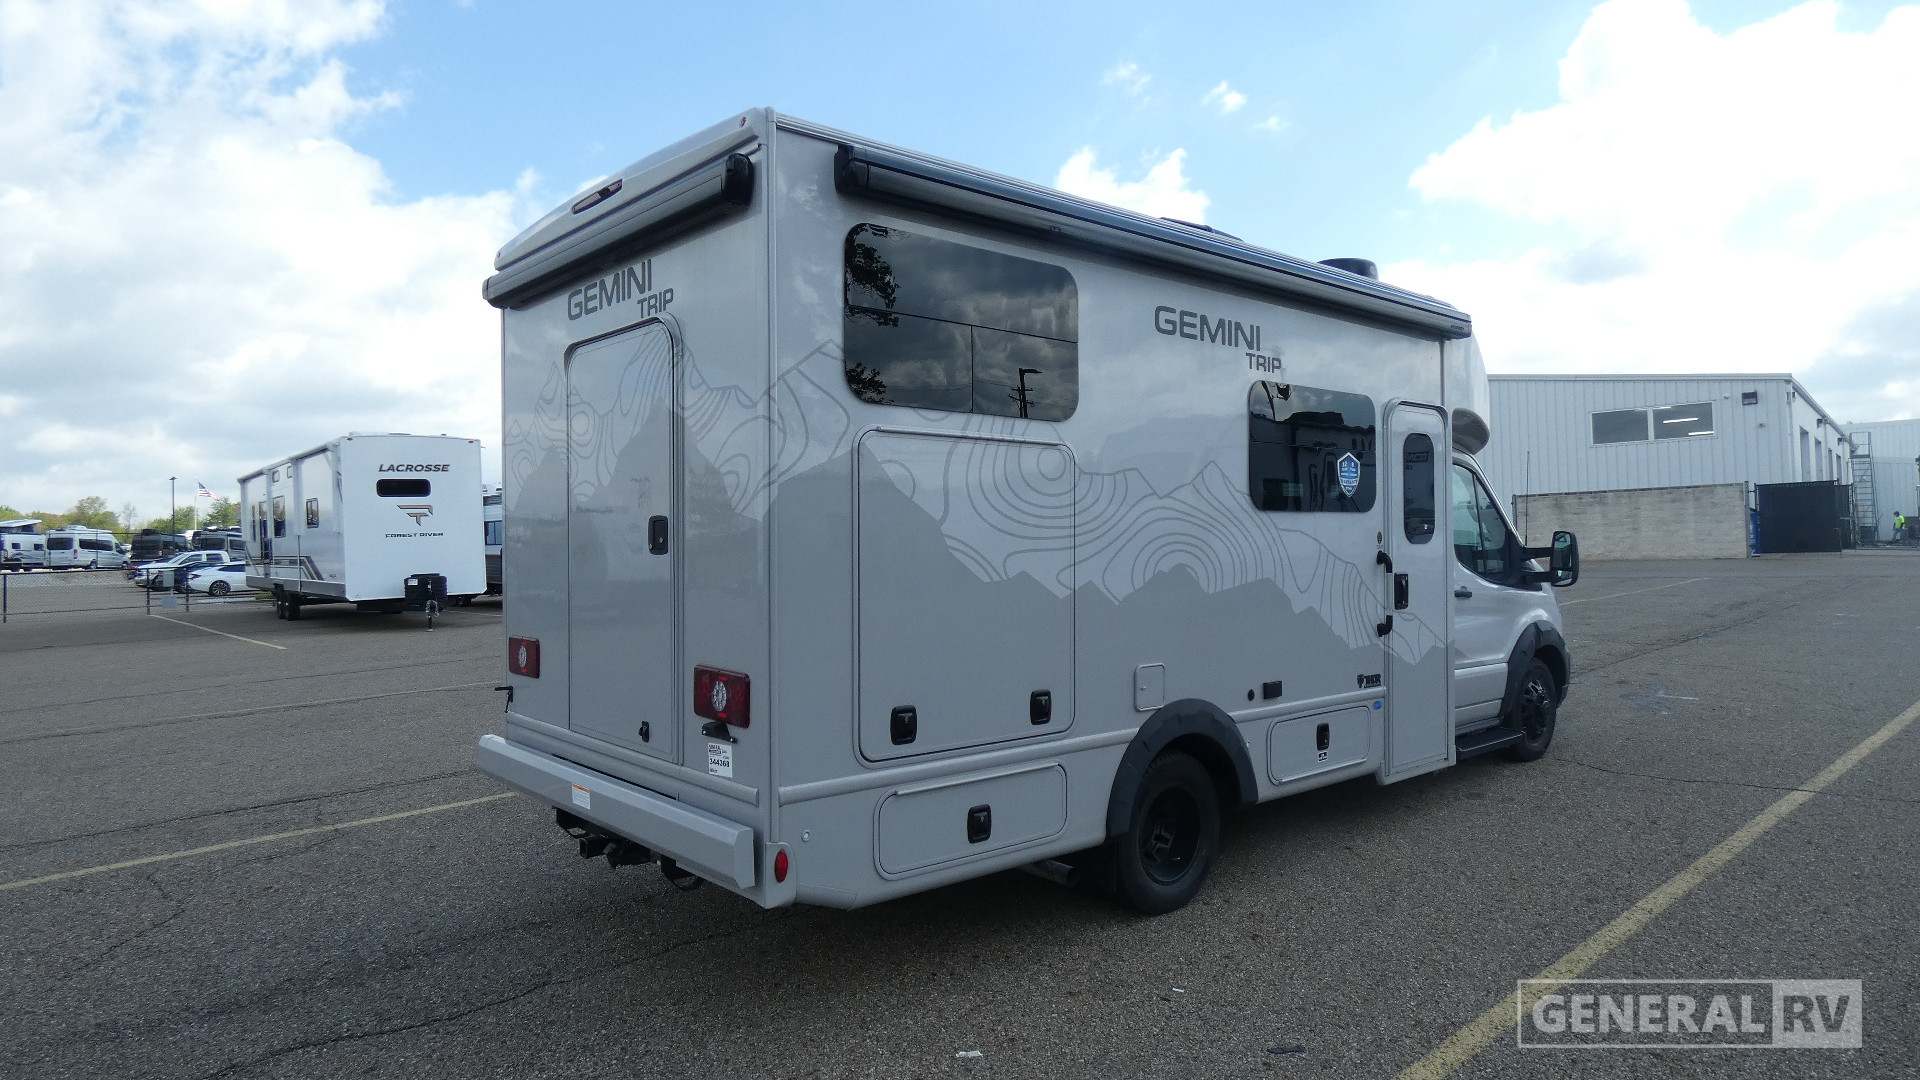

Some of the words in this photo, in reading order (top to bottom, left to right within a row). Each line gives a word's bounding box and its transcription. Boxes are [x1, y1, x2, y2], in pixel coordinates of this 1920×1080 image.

[567, 259, 652, 321] GEMINI
[637, 288, 674, 319] TRIP
[1154, 305, 1261, 351] GEMINI
[1245, 352, 1282, 373] TRIP
[378, 464, 450, 473] LACROSSE
